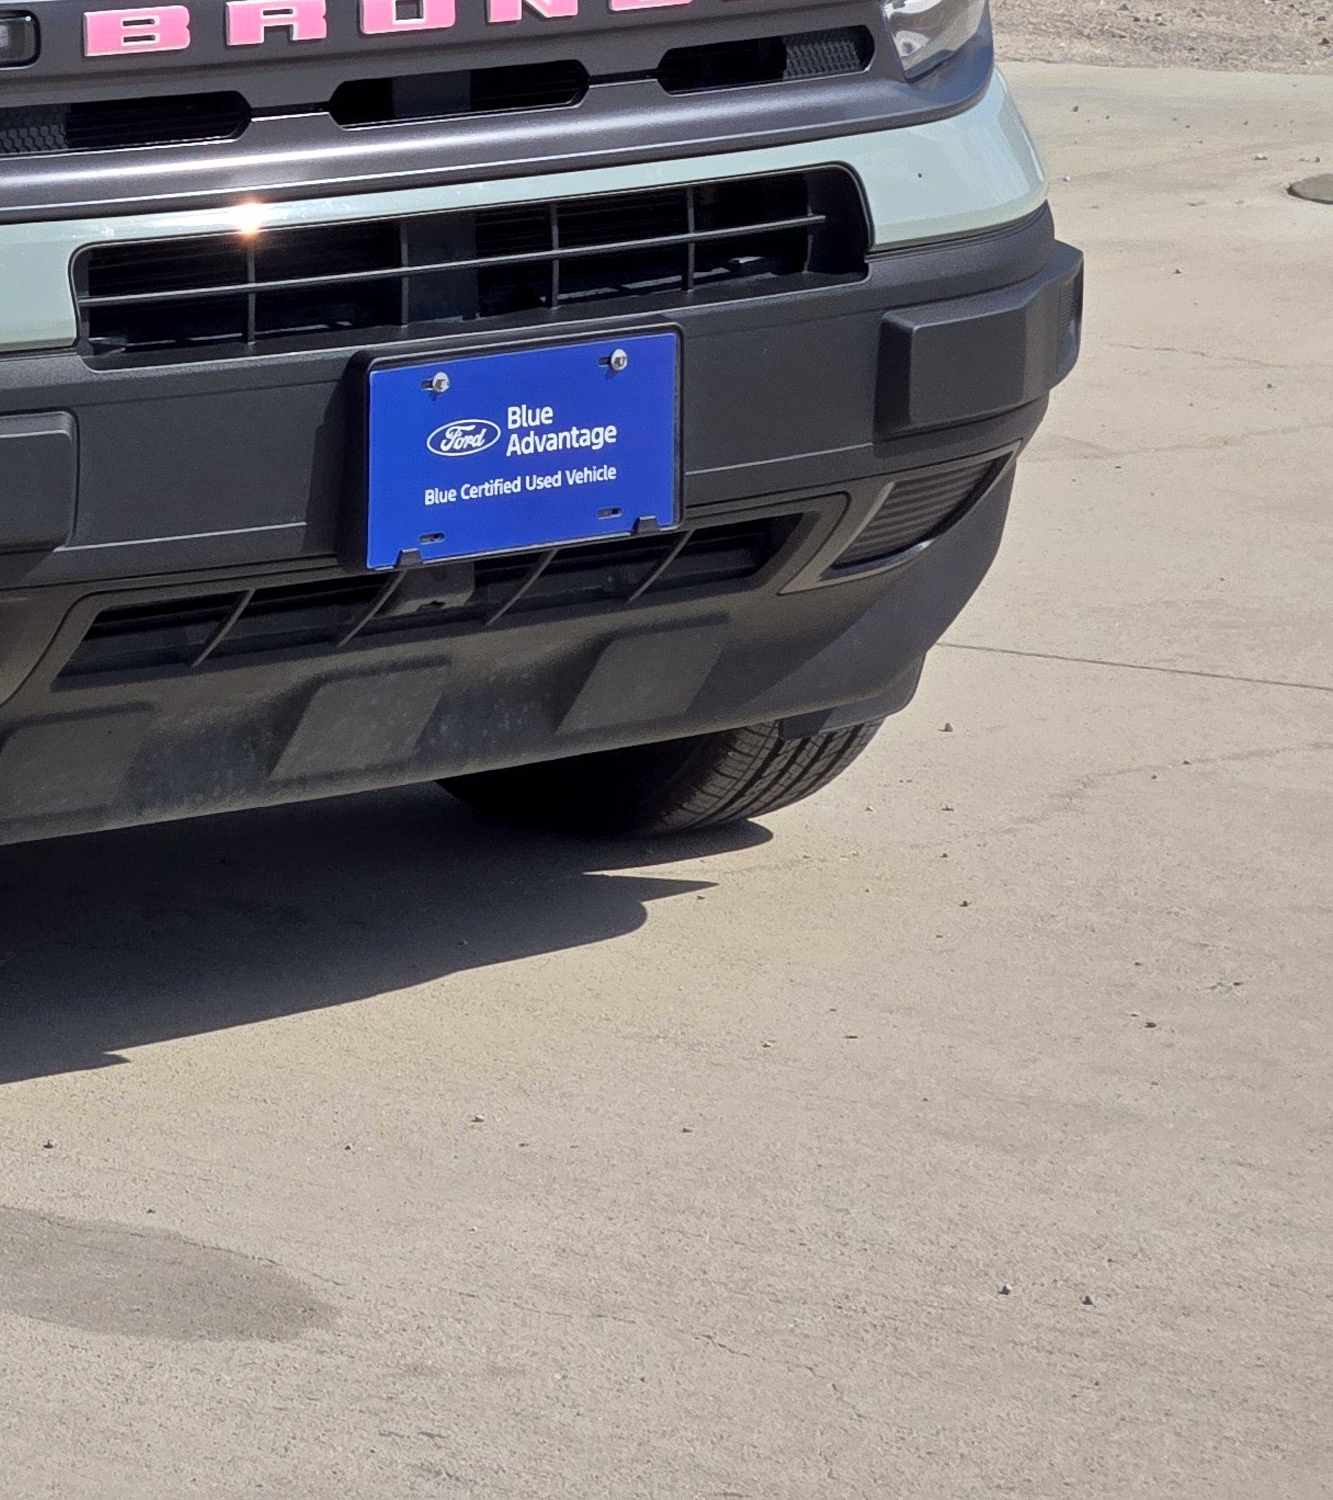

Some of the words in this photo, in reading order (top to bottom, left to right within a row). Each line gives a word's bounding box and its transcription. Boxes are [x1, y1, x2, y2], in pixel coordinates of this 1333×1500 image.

[507, 404, 554, 430] Blue
[506, 424, 618, 457] Advantage
[424, 488, 457, 506] Blue
[460, 476, 522, 500] Certified
[525, 470, 562, 491] Used
[565, 464, 618, 486] Vehicle
